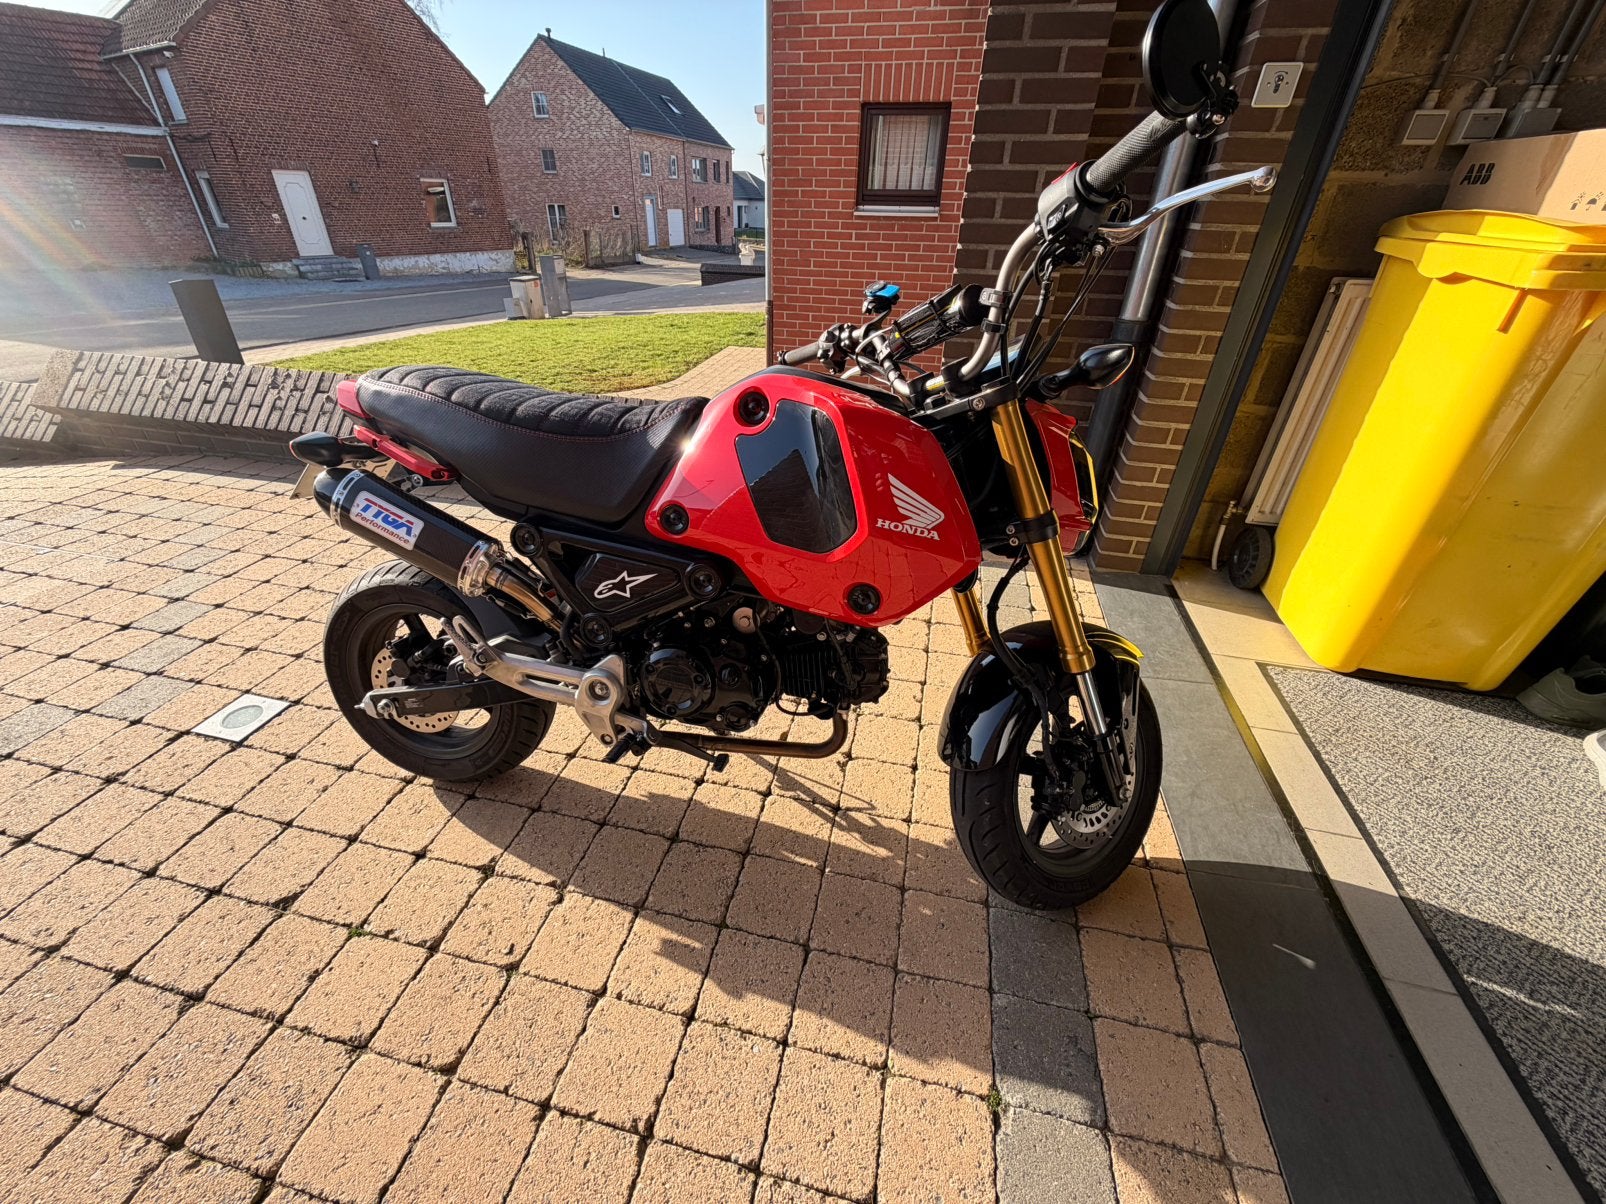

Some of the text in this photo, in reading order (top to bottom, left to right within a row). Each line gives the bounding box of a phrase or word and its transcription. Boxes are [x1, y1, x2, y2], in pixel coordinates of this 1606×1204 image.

[1459, 162, 1496, 186] ABB
[354, 512, 410, 544] Performance
[875, 518, 940, 541] HONDA
